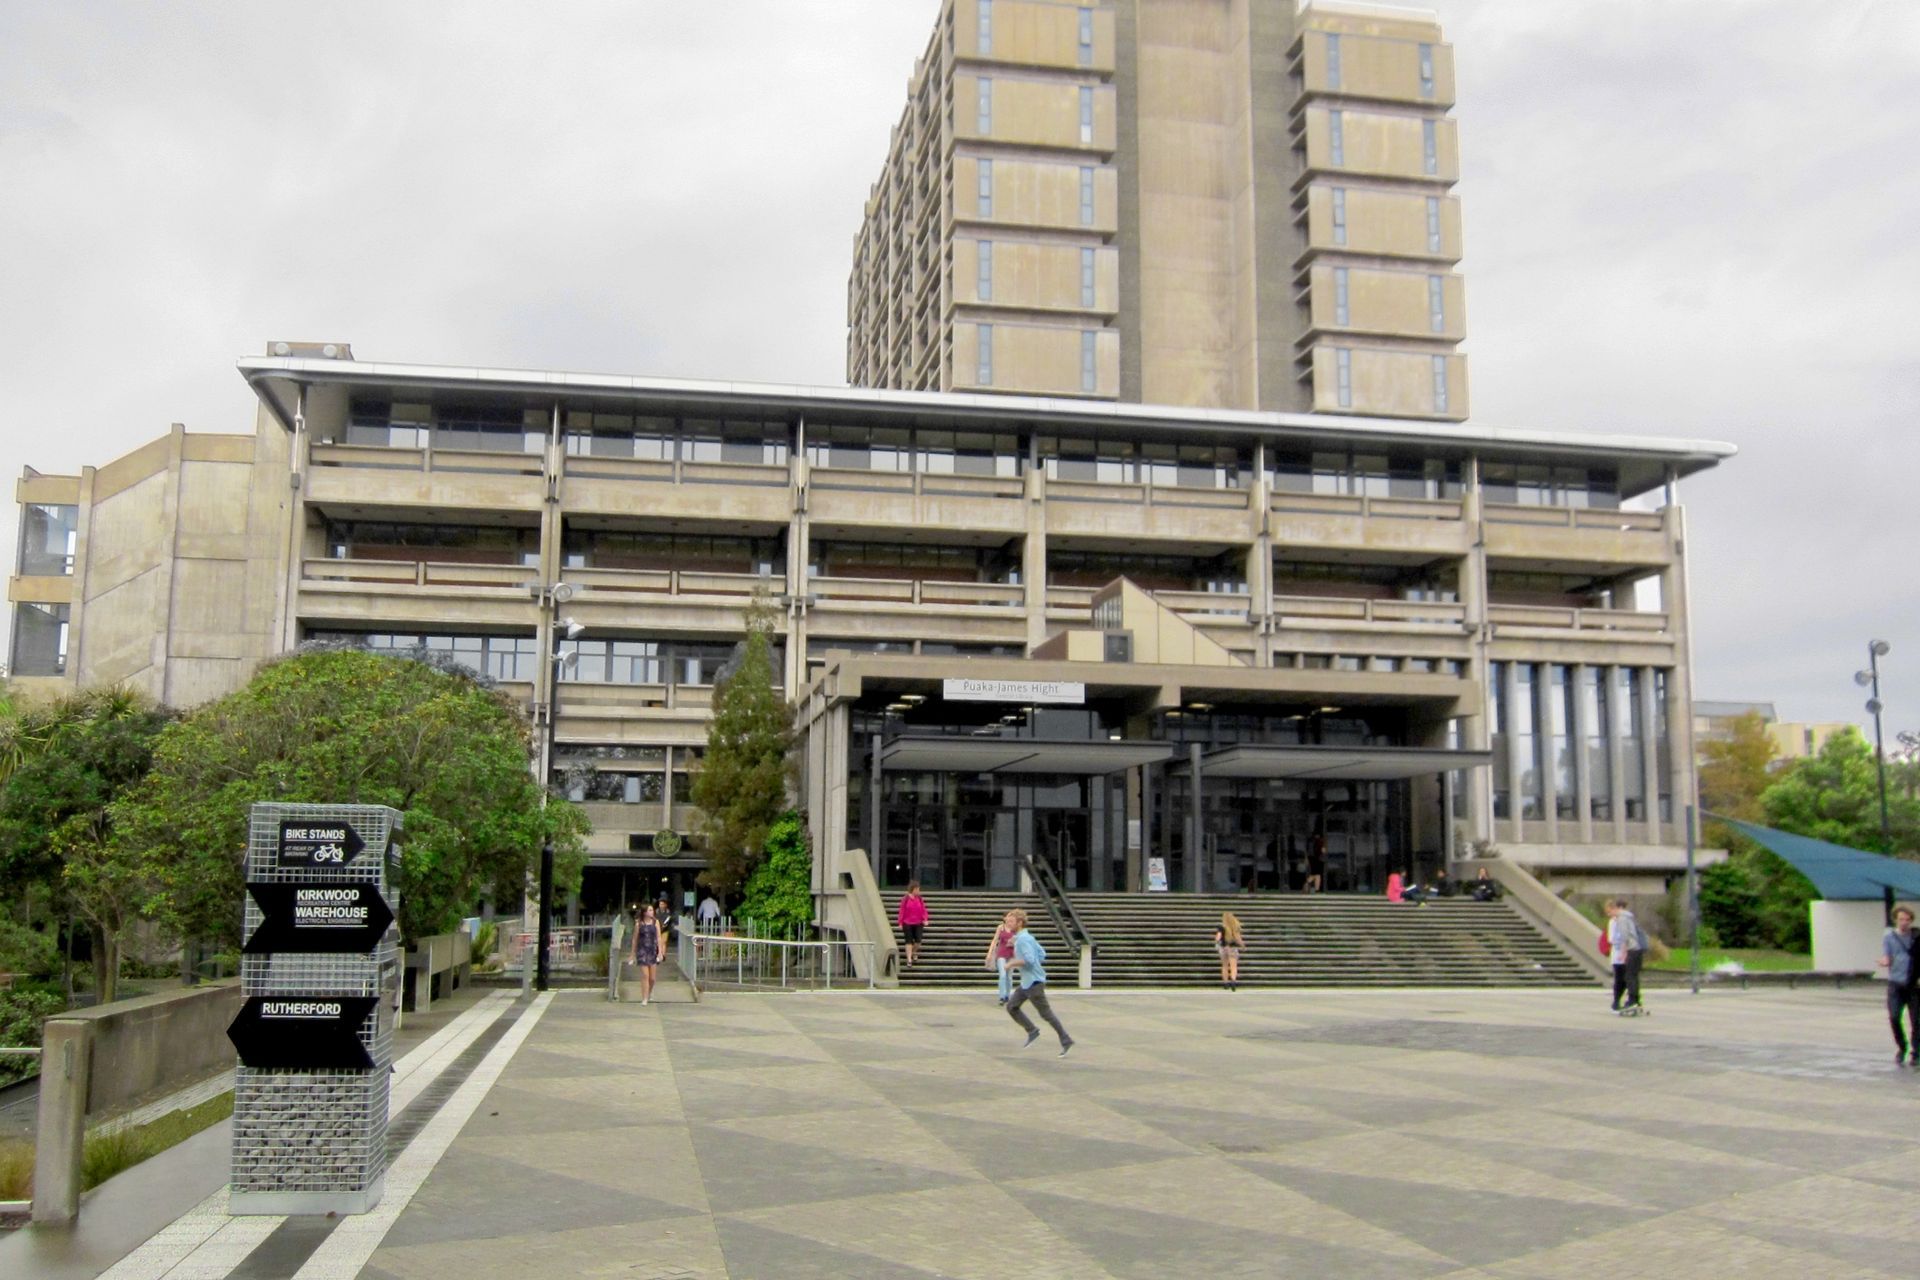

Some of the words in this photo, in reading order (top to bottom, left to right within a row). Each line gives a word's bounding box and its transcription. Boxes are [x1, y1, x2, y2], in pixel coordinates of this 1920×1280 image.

[963, 681, 1028, 693] Puaka-James
[1031, 684, 1059, 695] Hight
[285, 829, 308, 839] BIKE
[309, 829, 345, 840] STANDS
[297, 889, 360, 901] KIRKWOOD
[295, 906, 368, 918] WAREHOUSE
[262, 1002, 341, 1015] RUTHERFORD
